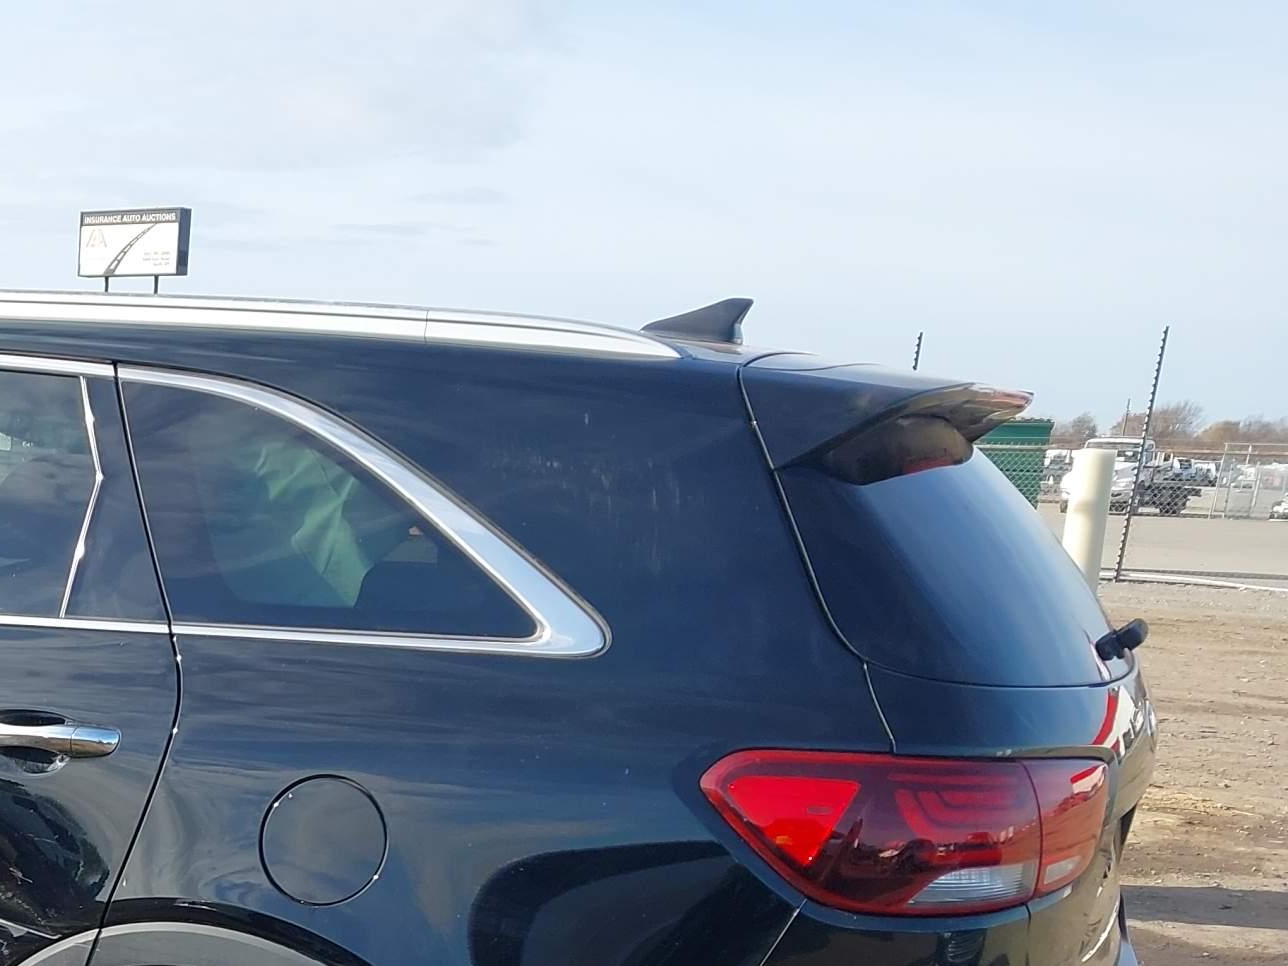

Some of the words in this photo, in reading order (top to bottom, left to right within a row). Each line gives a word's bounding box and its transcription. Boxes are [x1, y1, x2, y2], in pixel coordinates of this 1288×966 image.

[84, 214, 122, 225] INSURANCE
[123, 213, 141, 222] AUTO
[142, 212, 177, 222] AUCTIONS
